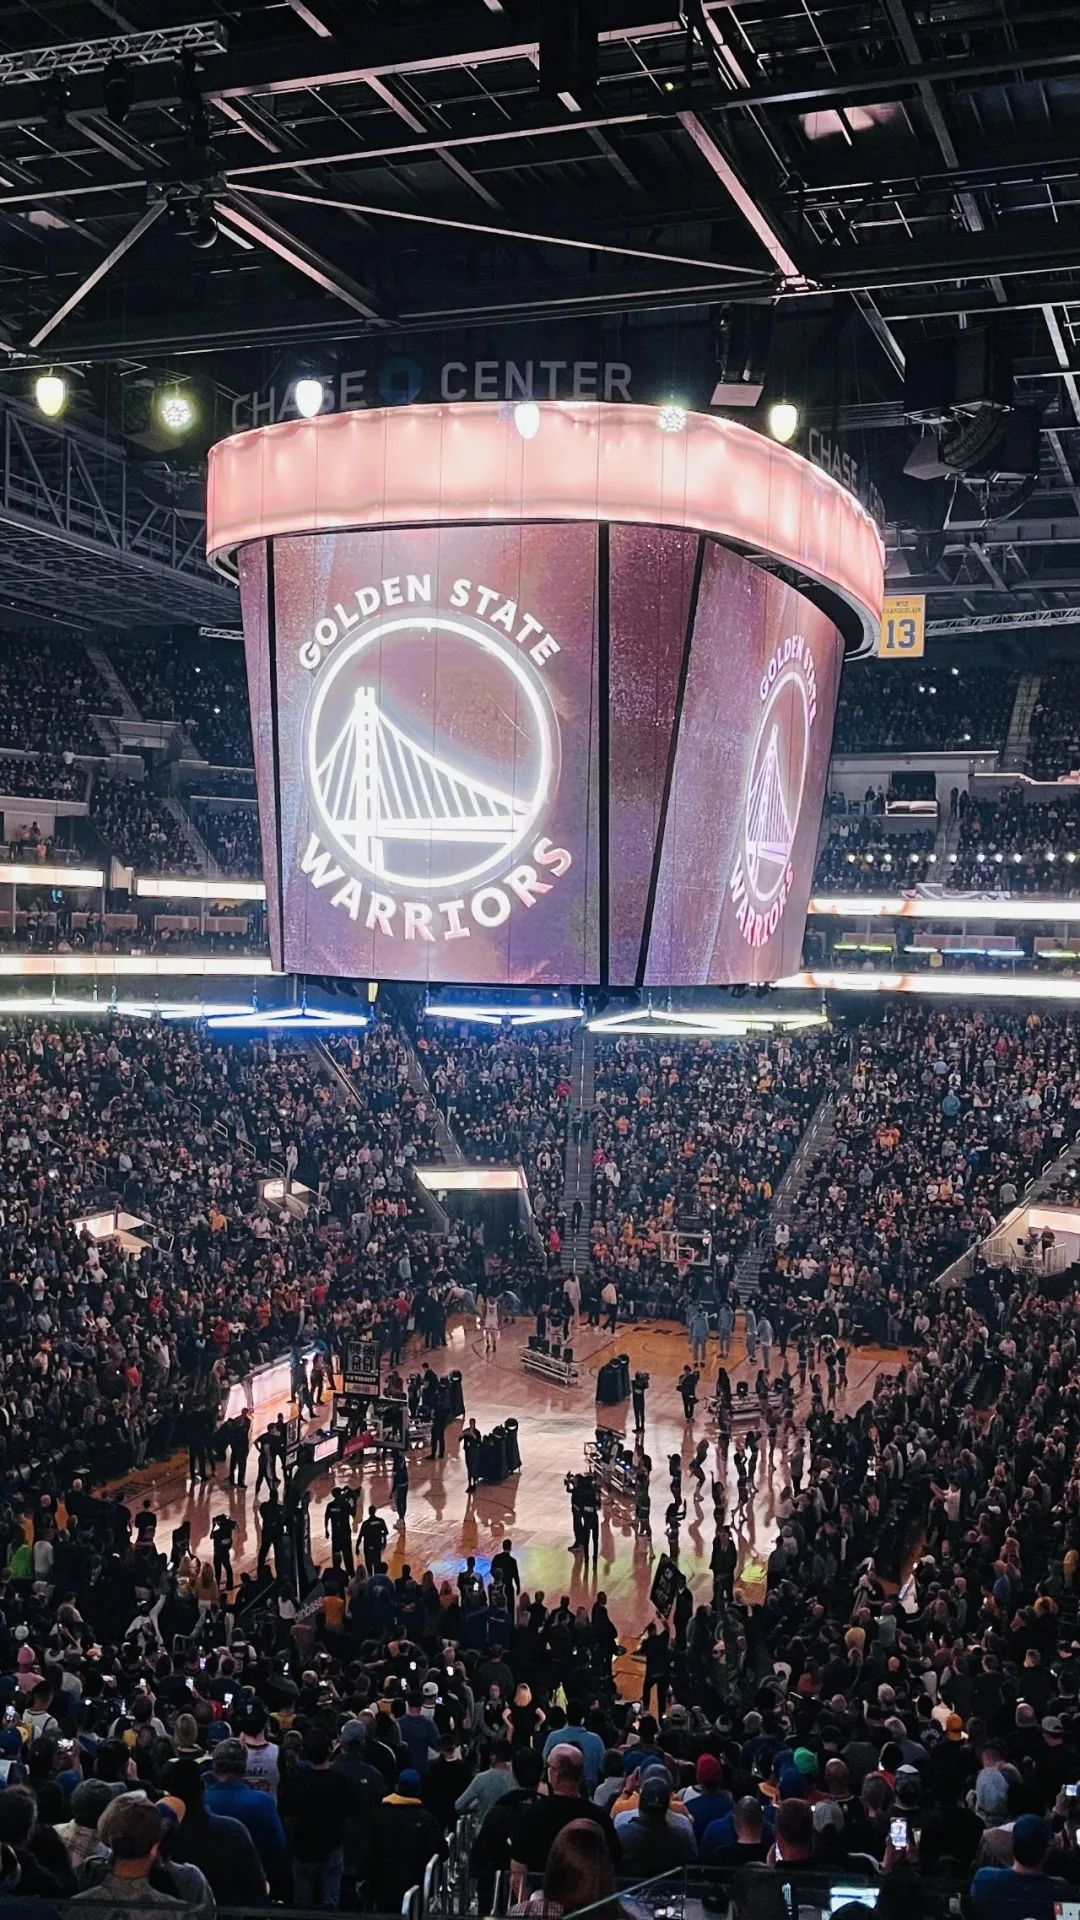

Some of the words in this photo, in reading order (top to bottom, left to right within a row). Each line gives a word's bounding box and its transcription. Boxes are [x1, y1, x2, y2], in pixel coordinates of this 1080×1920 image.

[441, 360, 633, 401] CENTER
[808, 427, 858, 495] CHASE
[299, 573, 432, 670] GOLDEN
[450, 578, 561, 666] STATE
[886, 618, 916, 649] 13
[760, 634, 805, 701] GOLDEN
[300, 832, 572, 942] WARRIORS
[729, 851, 794, 948] WARRIORS
